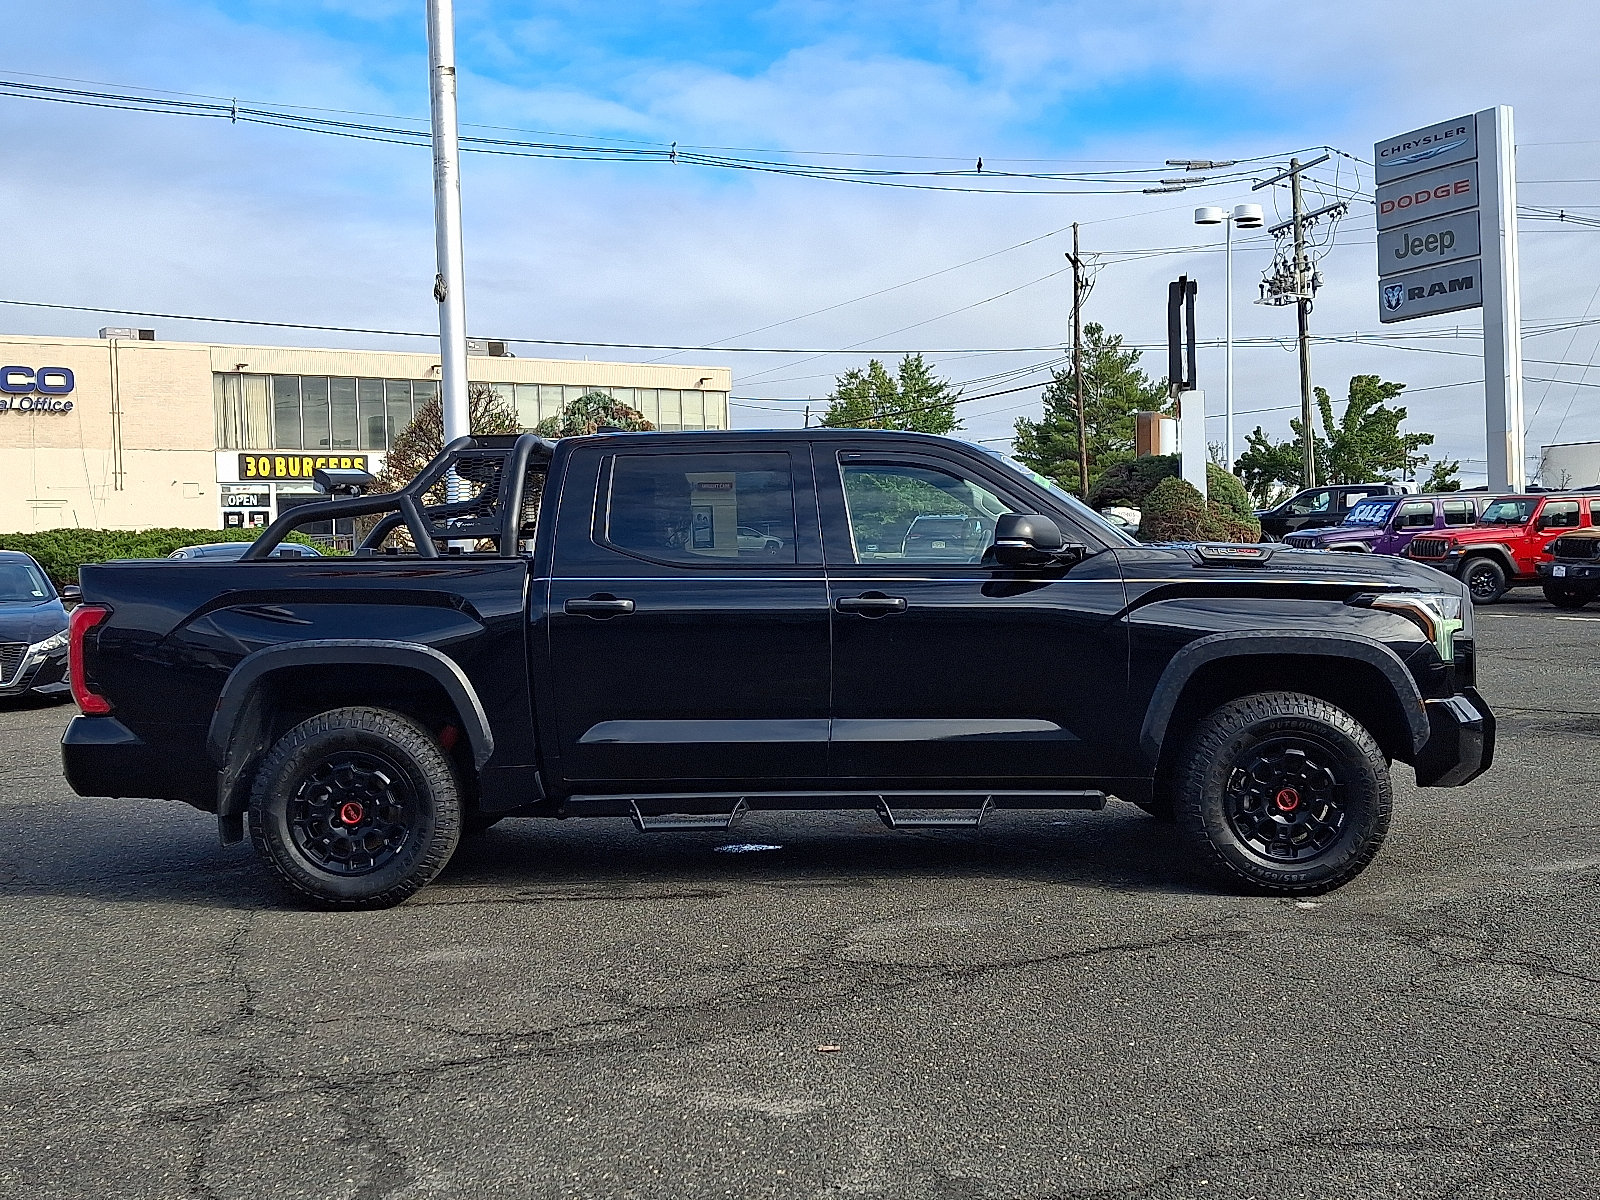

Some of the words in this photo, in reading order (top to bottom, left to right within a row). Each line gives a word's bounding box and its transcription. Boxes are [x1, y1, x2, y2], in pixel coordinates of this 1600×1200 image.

[1380, 126, 1467, 157] CHRYSLER
[1380, 179, 1470, 214] DODGE
[1395, 230, 1455, 259] Jeep
[1407, 275, 1474, 301] RAM
[19, 396, 74, 412] Office
[245, 456, 271, 477] 30
[227, 494, 258, 506] OPEN
[1344, 504, 1392, 523] SALE
[1208, 547, 1237, 555] TRD
